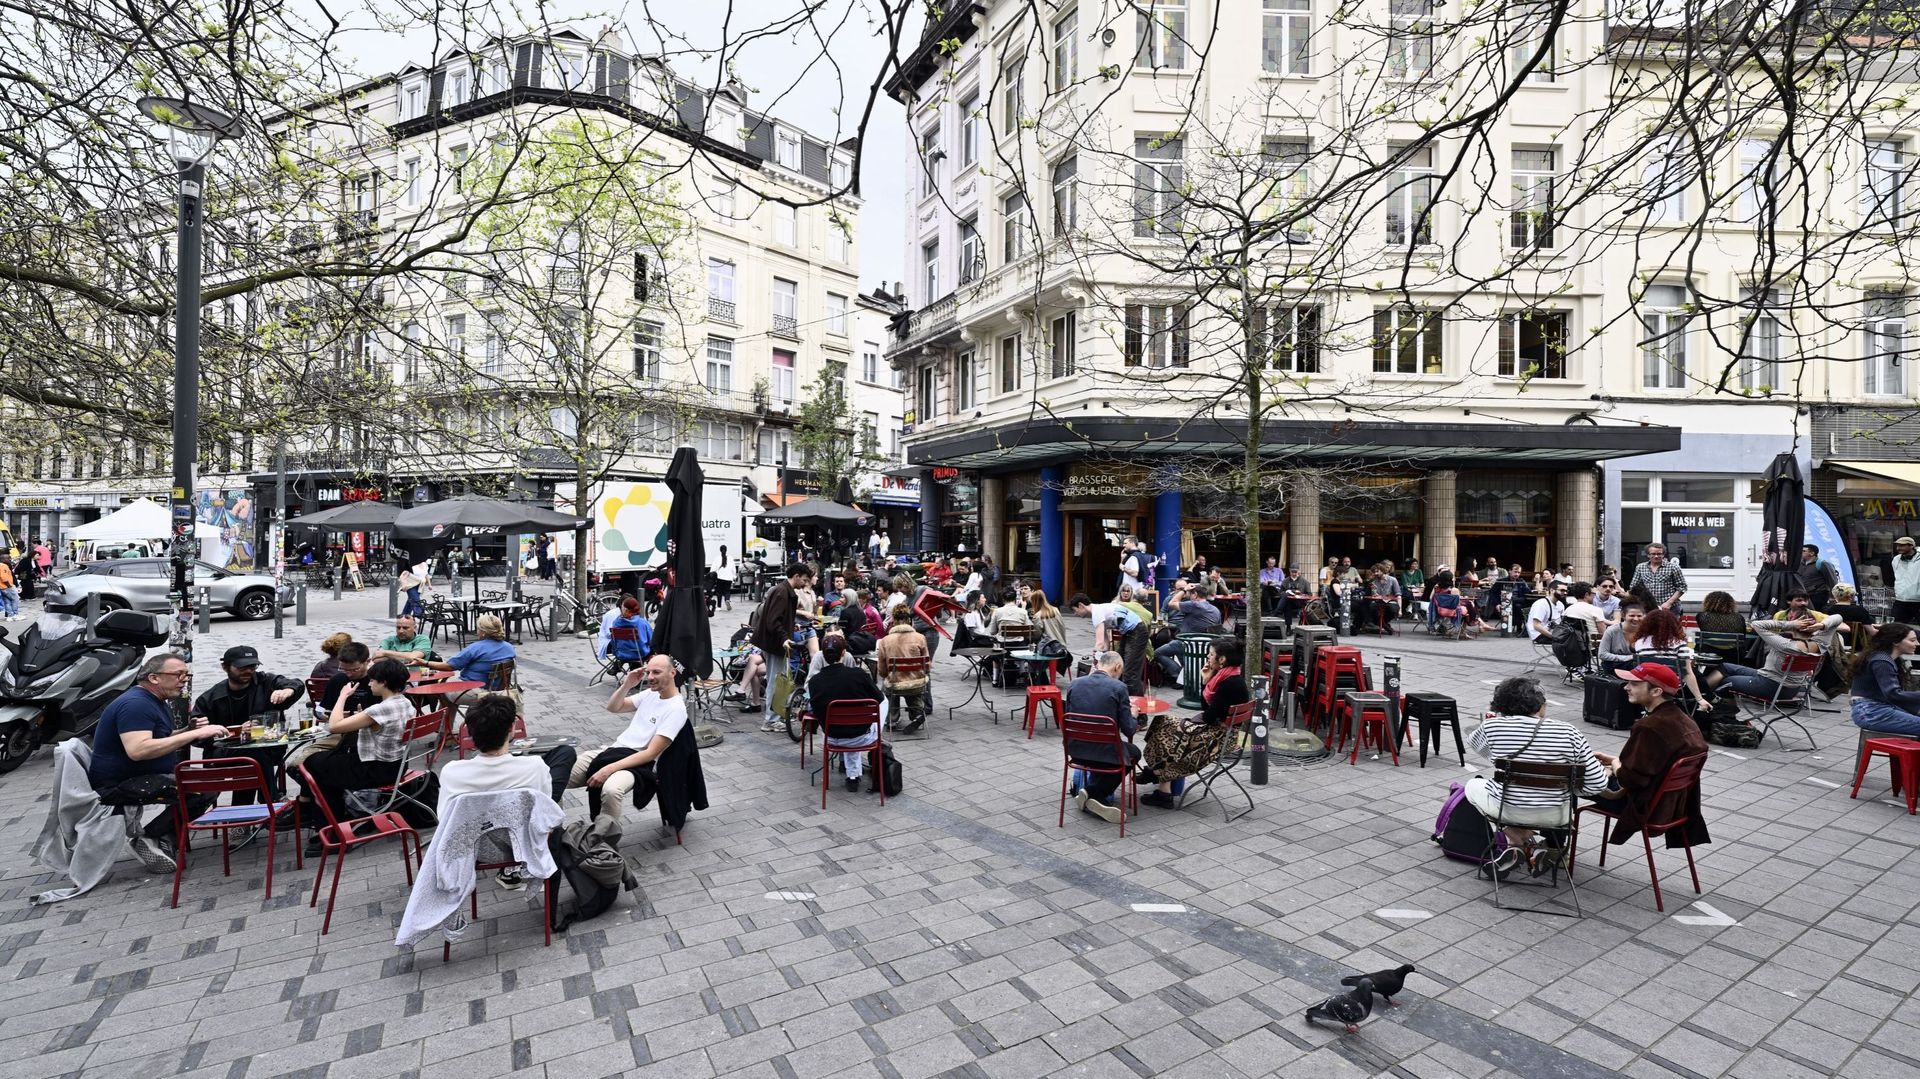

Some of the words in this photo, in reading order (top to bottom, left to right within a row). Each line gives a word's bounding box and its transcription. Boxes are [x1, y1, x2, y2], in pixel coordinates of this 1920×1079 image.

[933, 467, 959, 479] PRIMUS
[794, 479, 821, 487] HERMAN
[882, 476, 895, 489] De
[1068, 475, 1116, 485] BRASSERIE
[318, 488, 340, 501] EDAM
[1063, 486, 1126, 497] VERSCHUEREN
[701, 519, 731, 529] uatra
[1670, 516, 1696, 527] WASH
[1697, 516, 1705, 527] &
[1706, 517, 1725, 527] WEB
[465, 525, 501, 536] PEPSI
